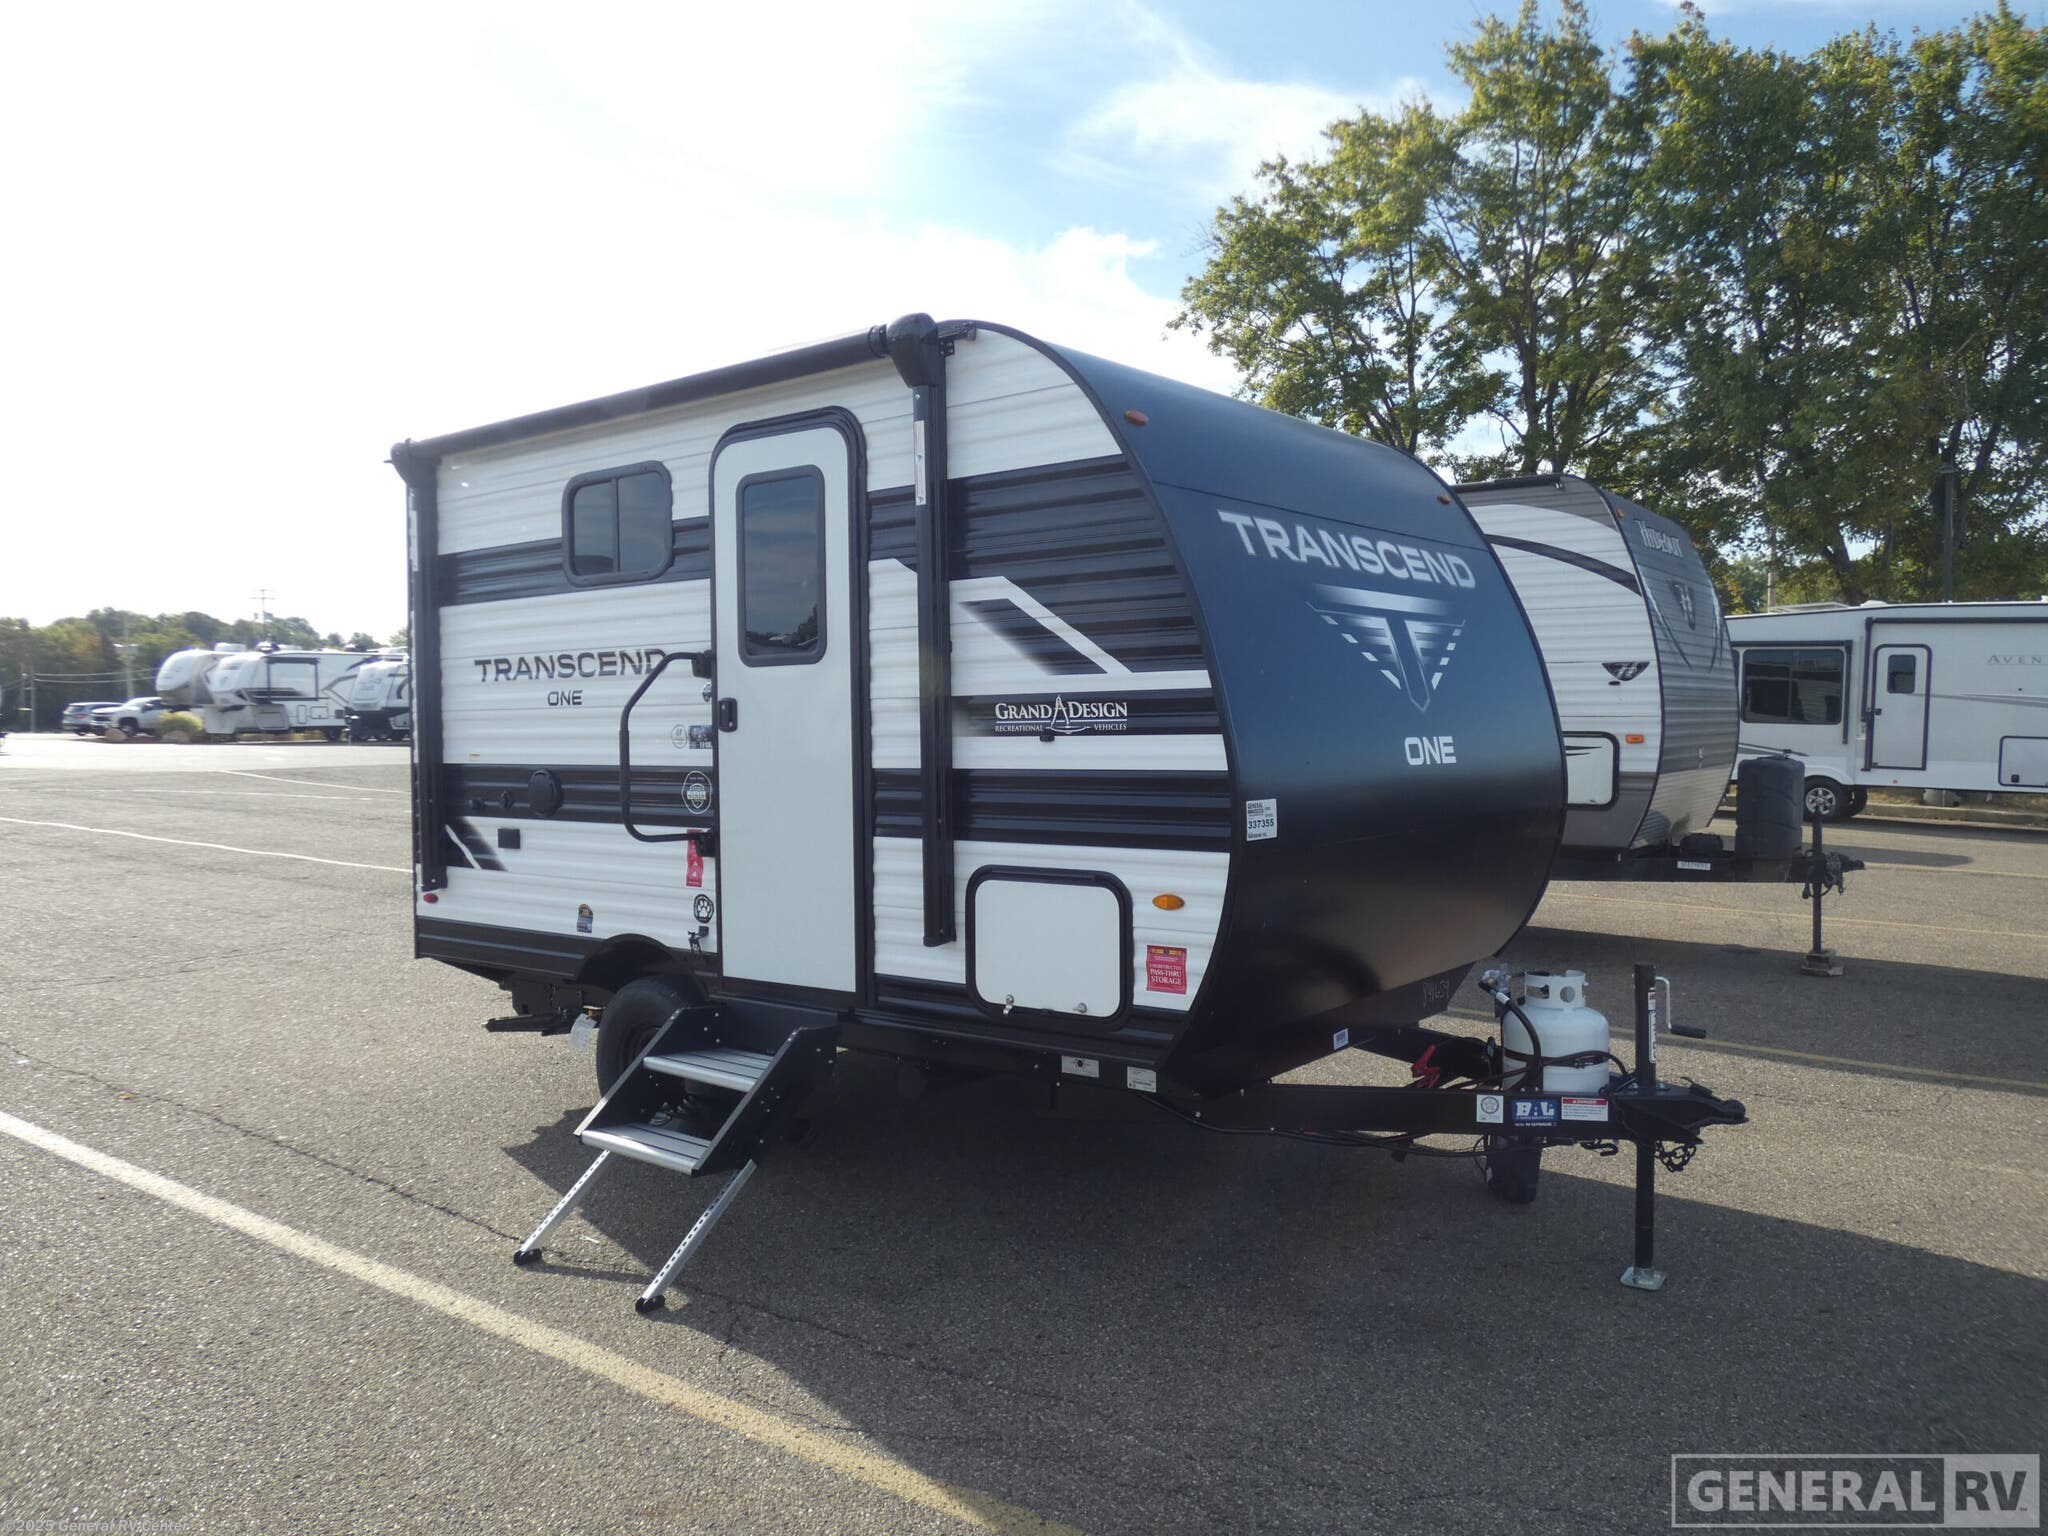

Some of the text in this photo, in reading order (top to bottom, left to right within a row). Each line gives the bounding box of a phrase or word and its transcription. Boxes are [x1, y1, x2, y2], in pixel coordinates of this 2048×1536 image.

[1217, 508, 1476, 589] TRANSCEND
[474, 648, 667, 682] TRANSCEND
[547, 689, 583, 707] ONE
[994, 701, 1128, 720] GRAND DESIGN
[994, 723, 1127, 732] RECREATIONAL VEHICLES
[1404, 736, 1457, 765] ONE
[1247, 818, 1274, 830] 337355
[1151, 975, 1181, 985] STORAGE
